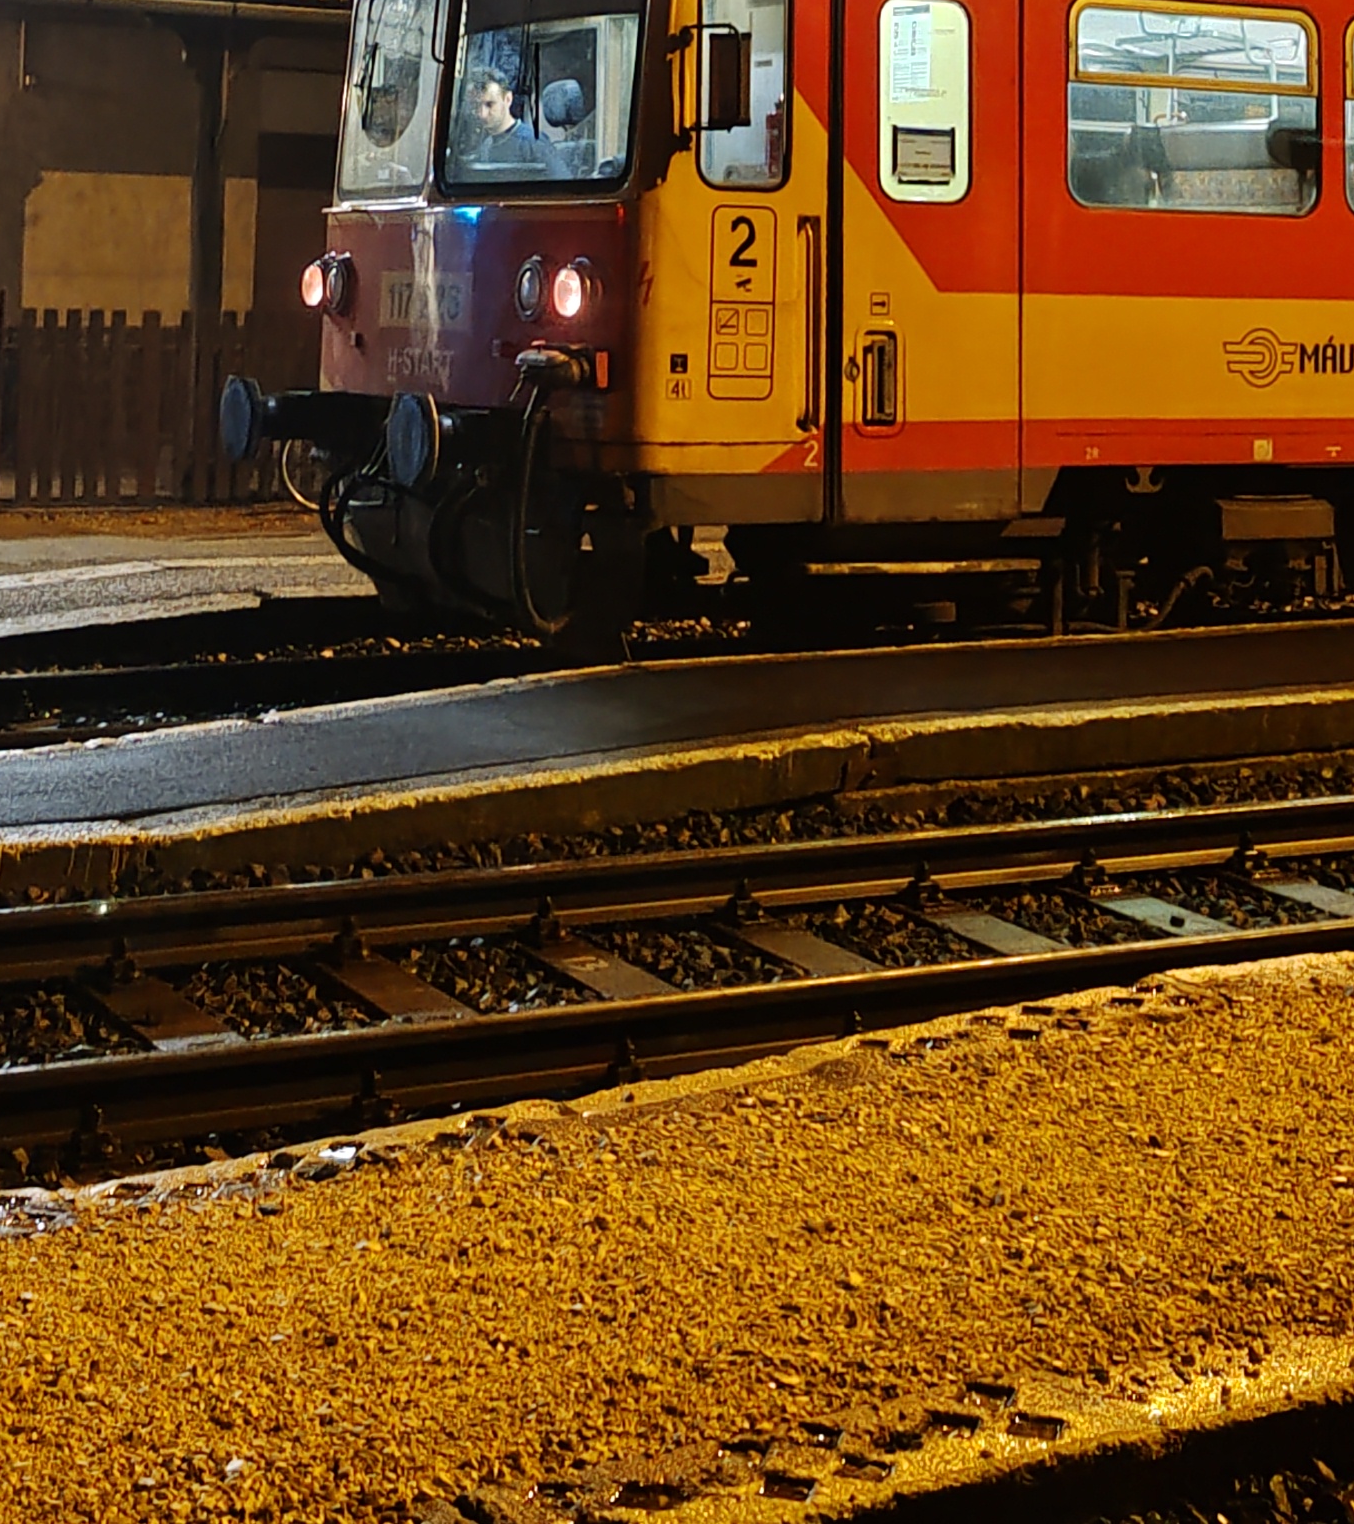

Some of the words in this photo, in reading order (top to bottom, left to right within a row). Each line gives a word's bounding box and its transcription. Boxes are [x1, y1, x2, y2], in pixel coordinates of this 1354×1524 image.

[729, 215, 758, 268] 2
[387, 347, 454, 376] H-START
[803, 440, 819, 467] 2
